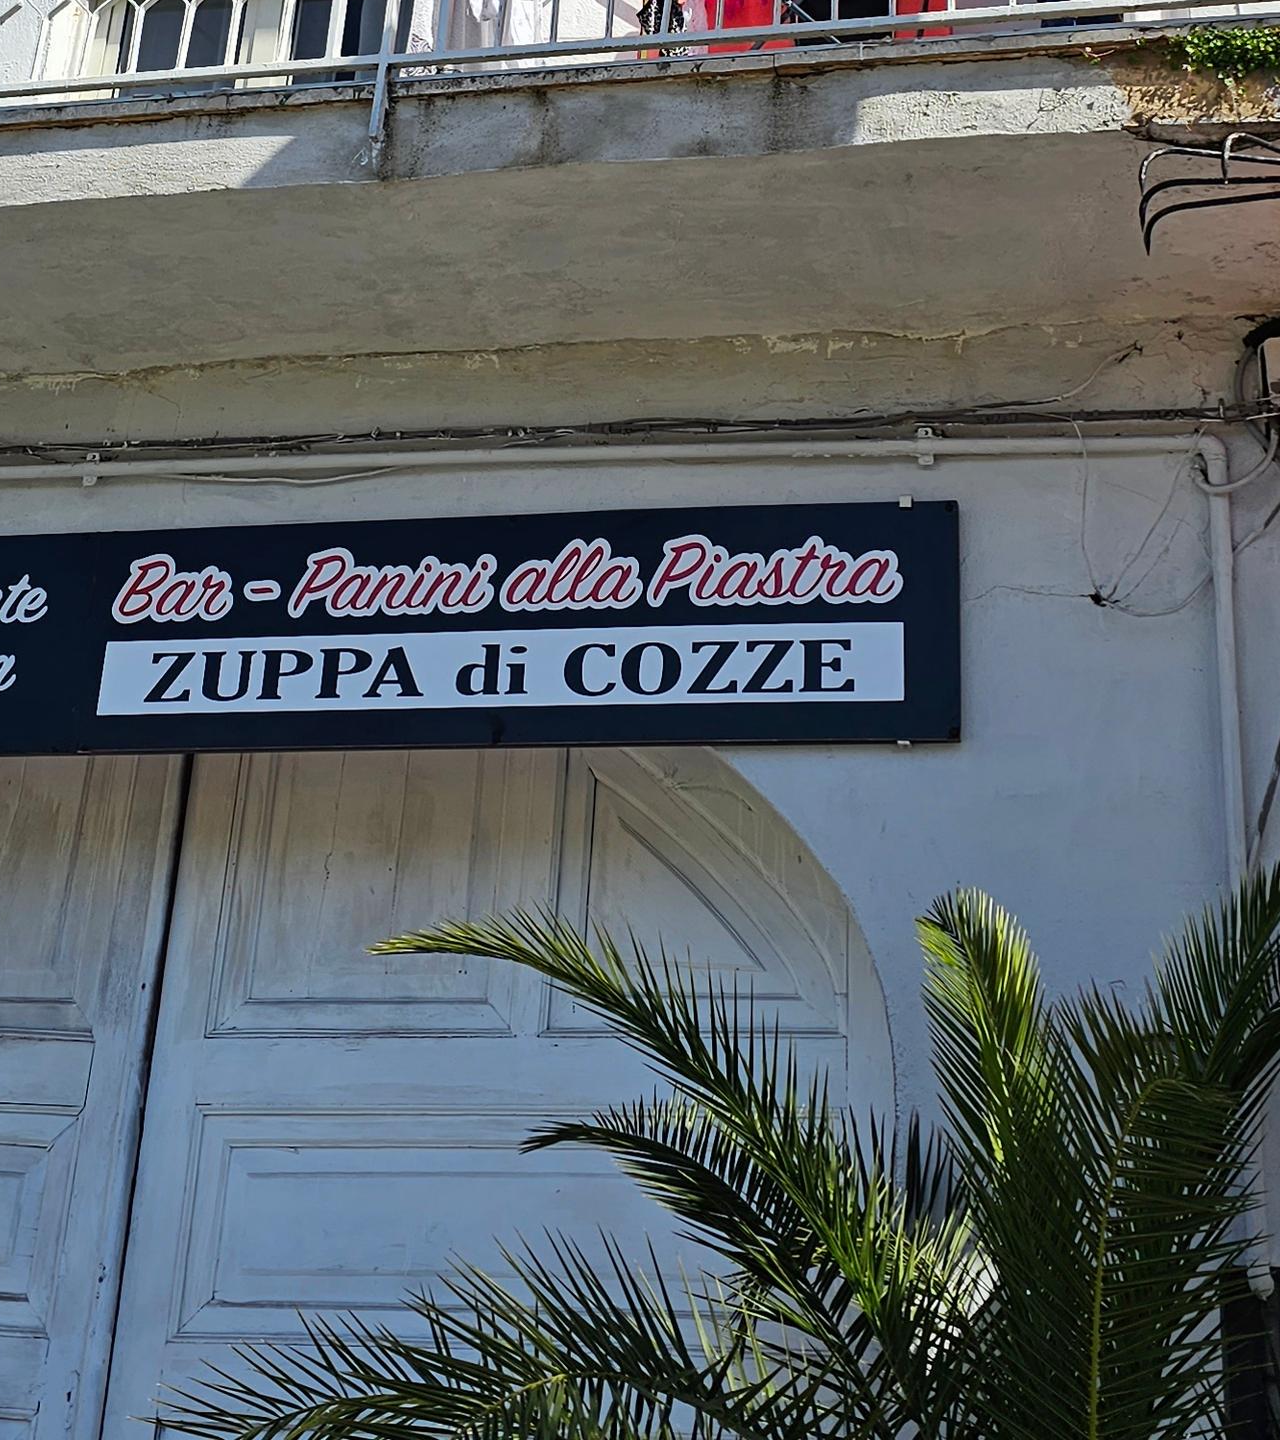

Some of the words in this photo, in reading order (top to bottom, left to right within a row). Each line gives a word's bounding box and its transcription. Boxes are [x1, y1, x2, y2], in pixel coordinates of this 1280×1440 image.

[111, 553, 233, 624] Bar
[288, 547, 497, 618] Panini
[499, 538, 643, 612] alla
[646, 534, 903, 608] Piastra
[143, 646, 423, 702] ZUPPA
[455, 643, 529, 696] di
[562, 639, 856, 696] COZZE
